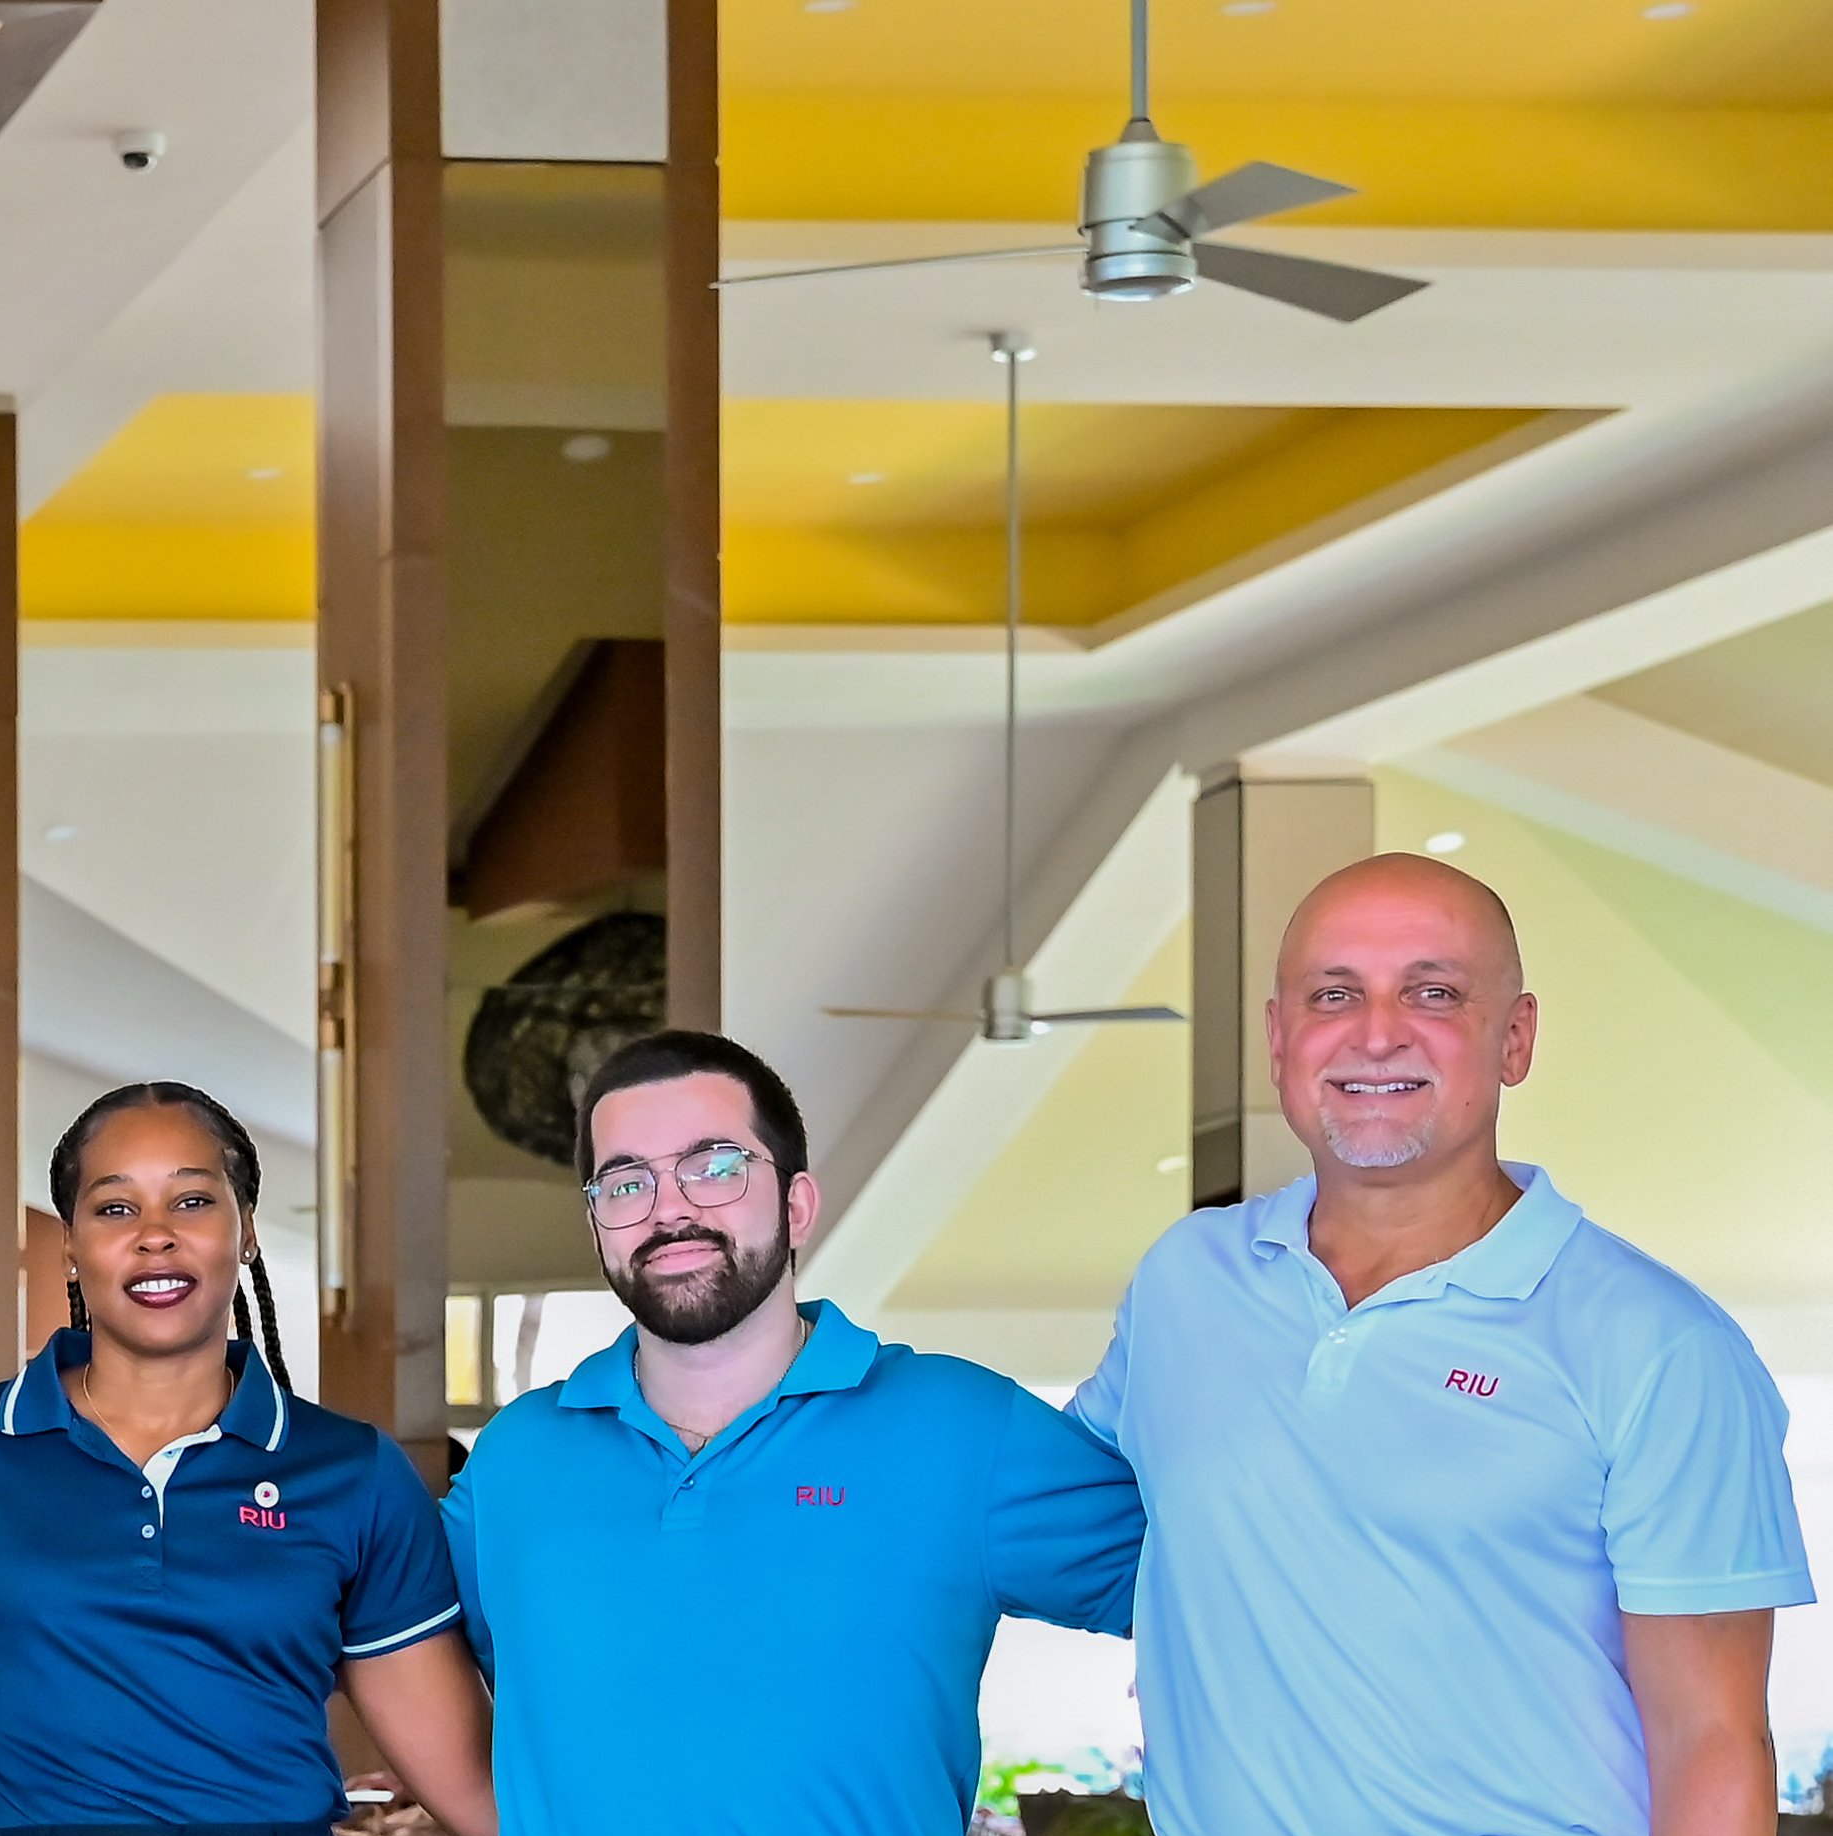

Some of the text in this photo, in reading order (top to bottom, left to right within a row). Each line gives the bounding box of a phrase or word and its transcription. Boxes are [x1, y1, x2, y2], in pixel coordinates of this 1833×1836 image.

[1444, 1368, 1500, 1397] RIU
[796, 1486, 845, 1506] RIU
[239, 1506, 286, 1530] RIU
